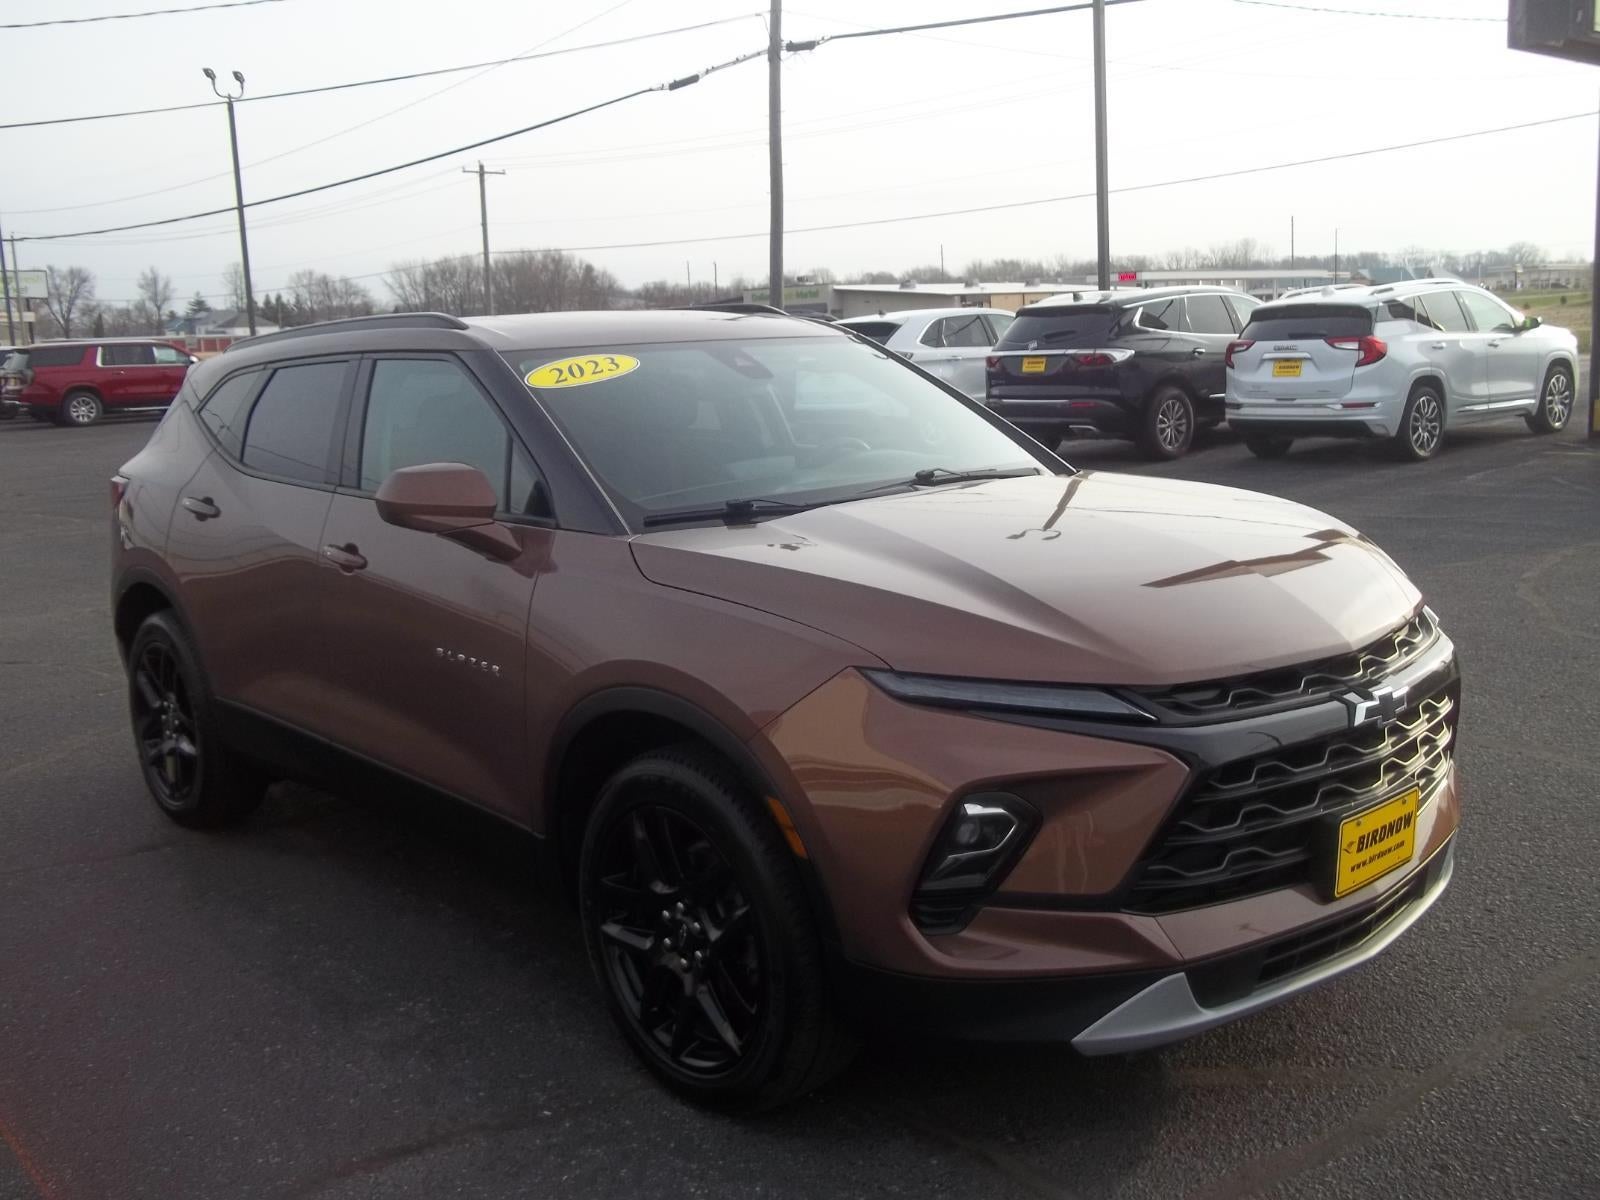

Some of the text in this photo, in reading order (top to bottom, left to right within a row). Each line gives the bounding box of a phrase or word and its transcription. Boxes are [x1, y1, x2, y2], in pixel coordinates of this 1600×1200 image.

[549, 356, 620, 384] 2023
[1356, 811, 1413, 854] BIRDNOW
[1350, 840, 1405, 872] www.birdnow.com
